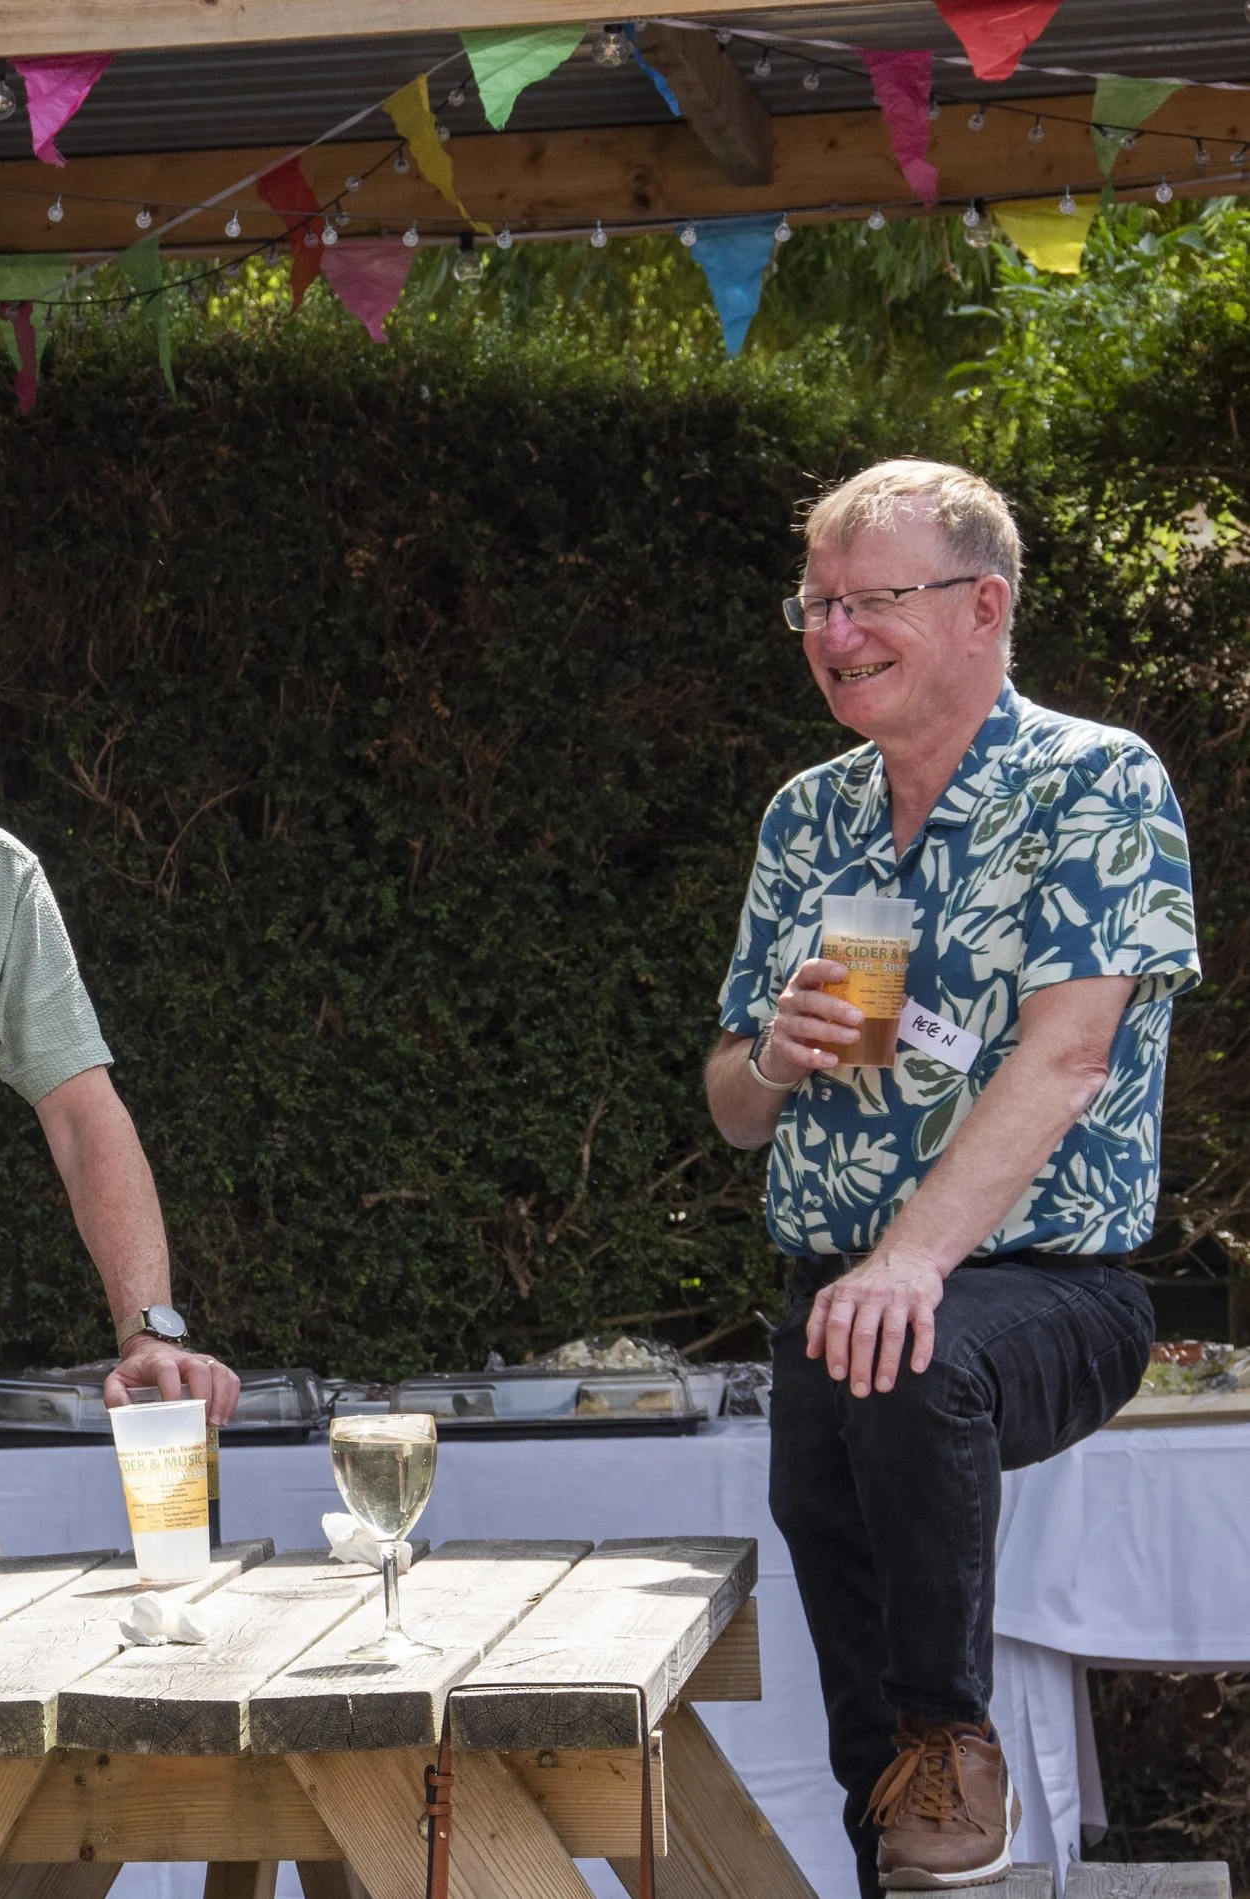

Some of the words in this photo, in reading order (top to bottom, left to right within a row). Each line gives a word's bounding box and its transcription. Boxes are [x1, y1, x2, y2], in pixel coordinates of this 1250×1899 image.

[840, 936, 878, 945] Winchester
[845, 946, 888, 959] CIDER
[891, 948, 898, 960] &
[846, 960, 874, 972] 28TH
[912, 1015, 942, 1038] PETE
[941, 1034, 958, 1047] N
[149, 1458, 161, 1470] &
[164, 1452, 204, 1468] MUSIC
